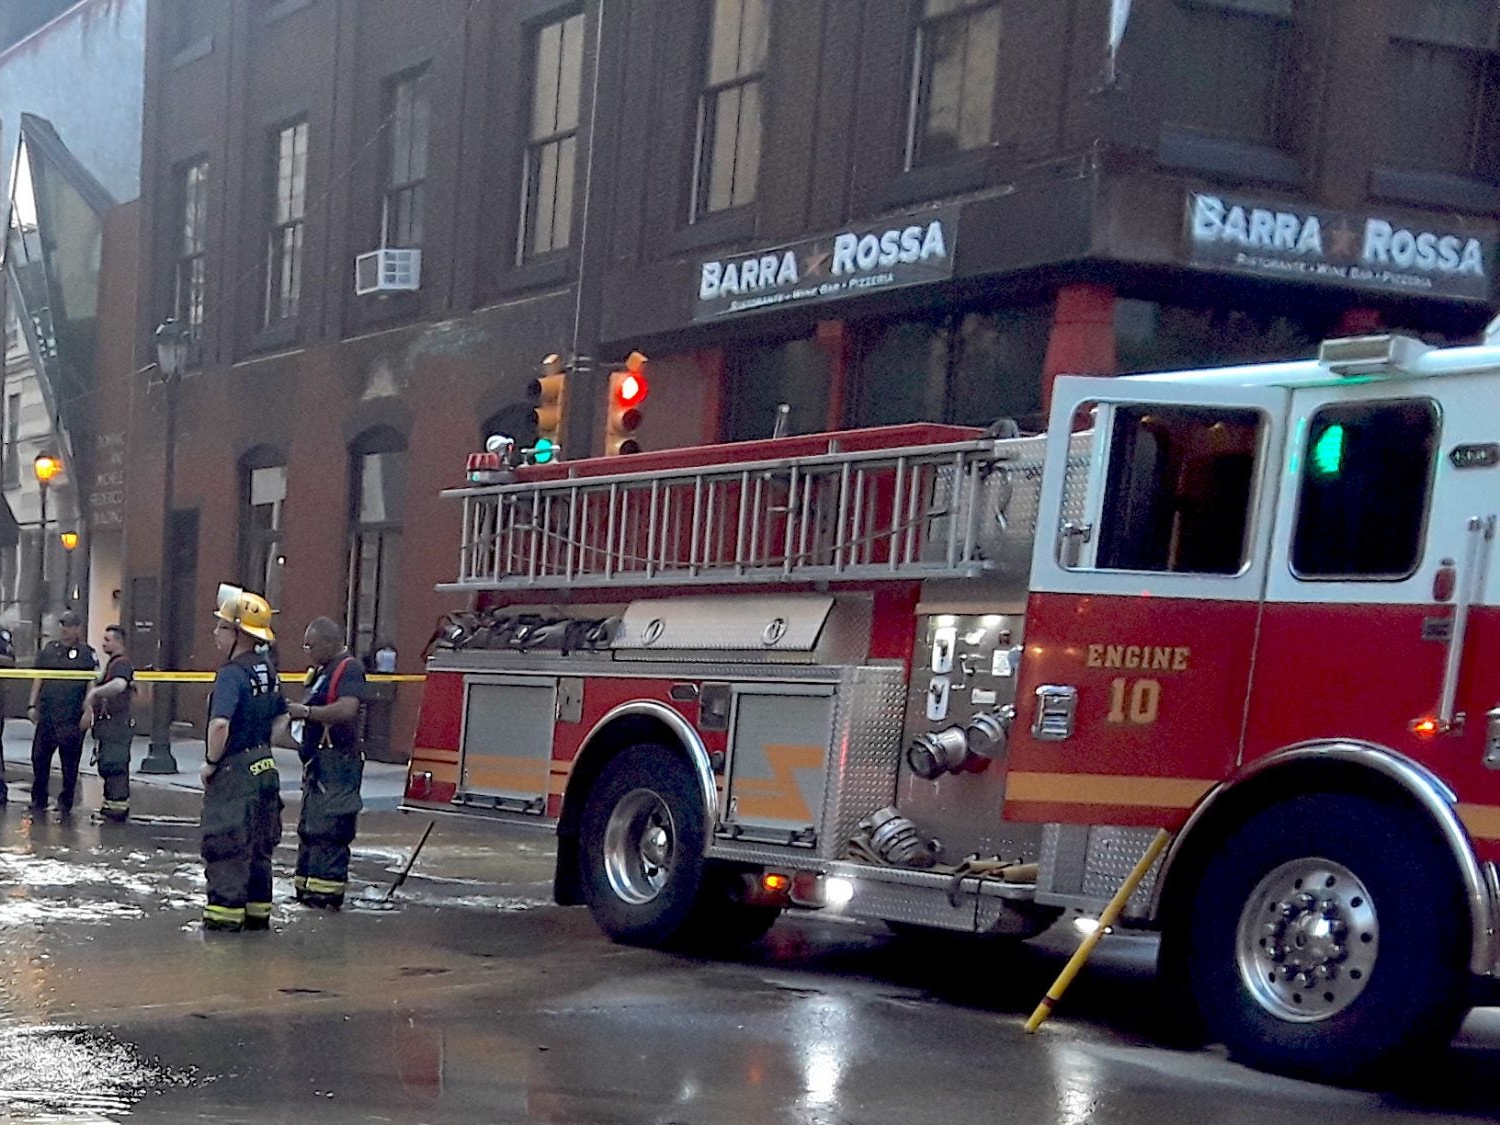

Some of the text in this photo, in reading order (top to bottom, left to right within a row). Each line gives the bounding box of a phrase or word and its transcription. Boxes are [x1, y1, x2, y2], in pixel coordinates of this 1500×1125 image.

[1192, 194, 1484, 277] BARRA ROSSA
[699, 219, 947, 301] BARRA ROSSA
[849, 272, 896, 288] PIZZERIA
[1087, 643, 1191, 671] ENGINE
[1106, 676, 1161, 724] 10
